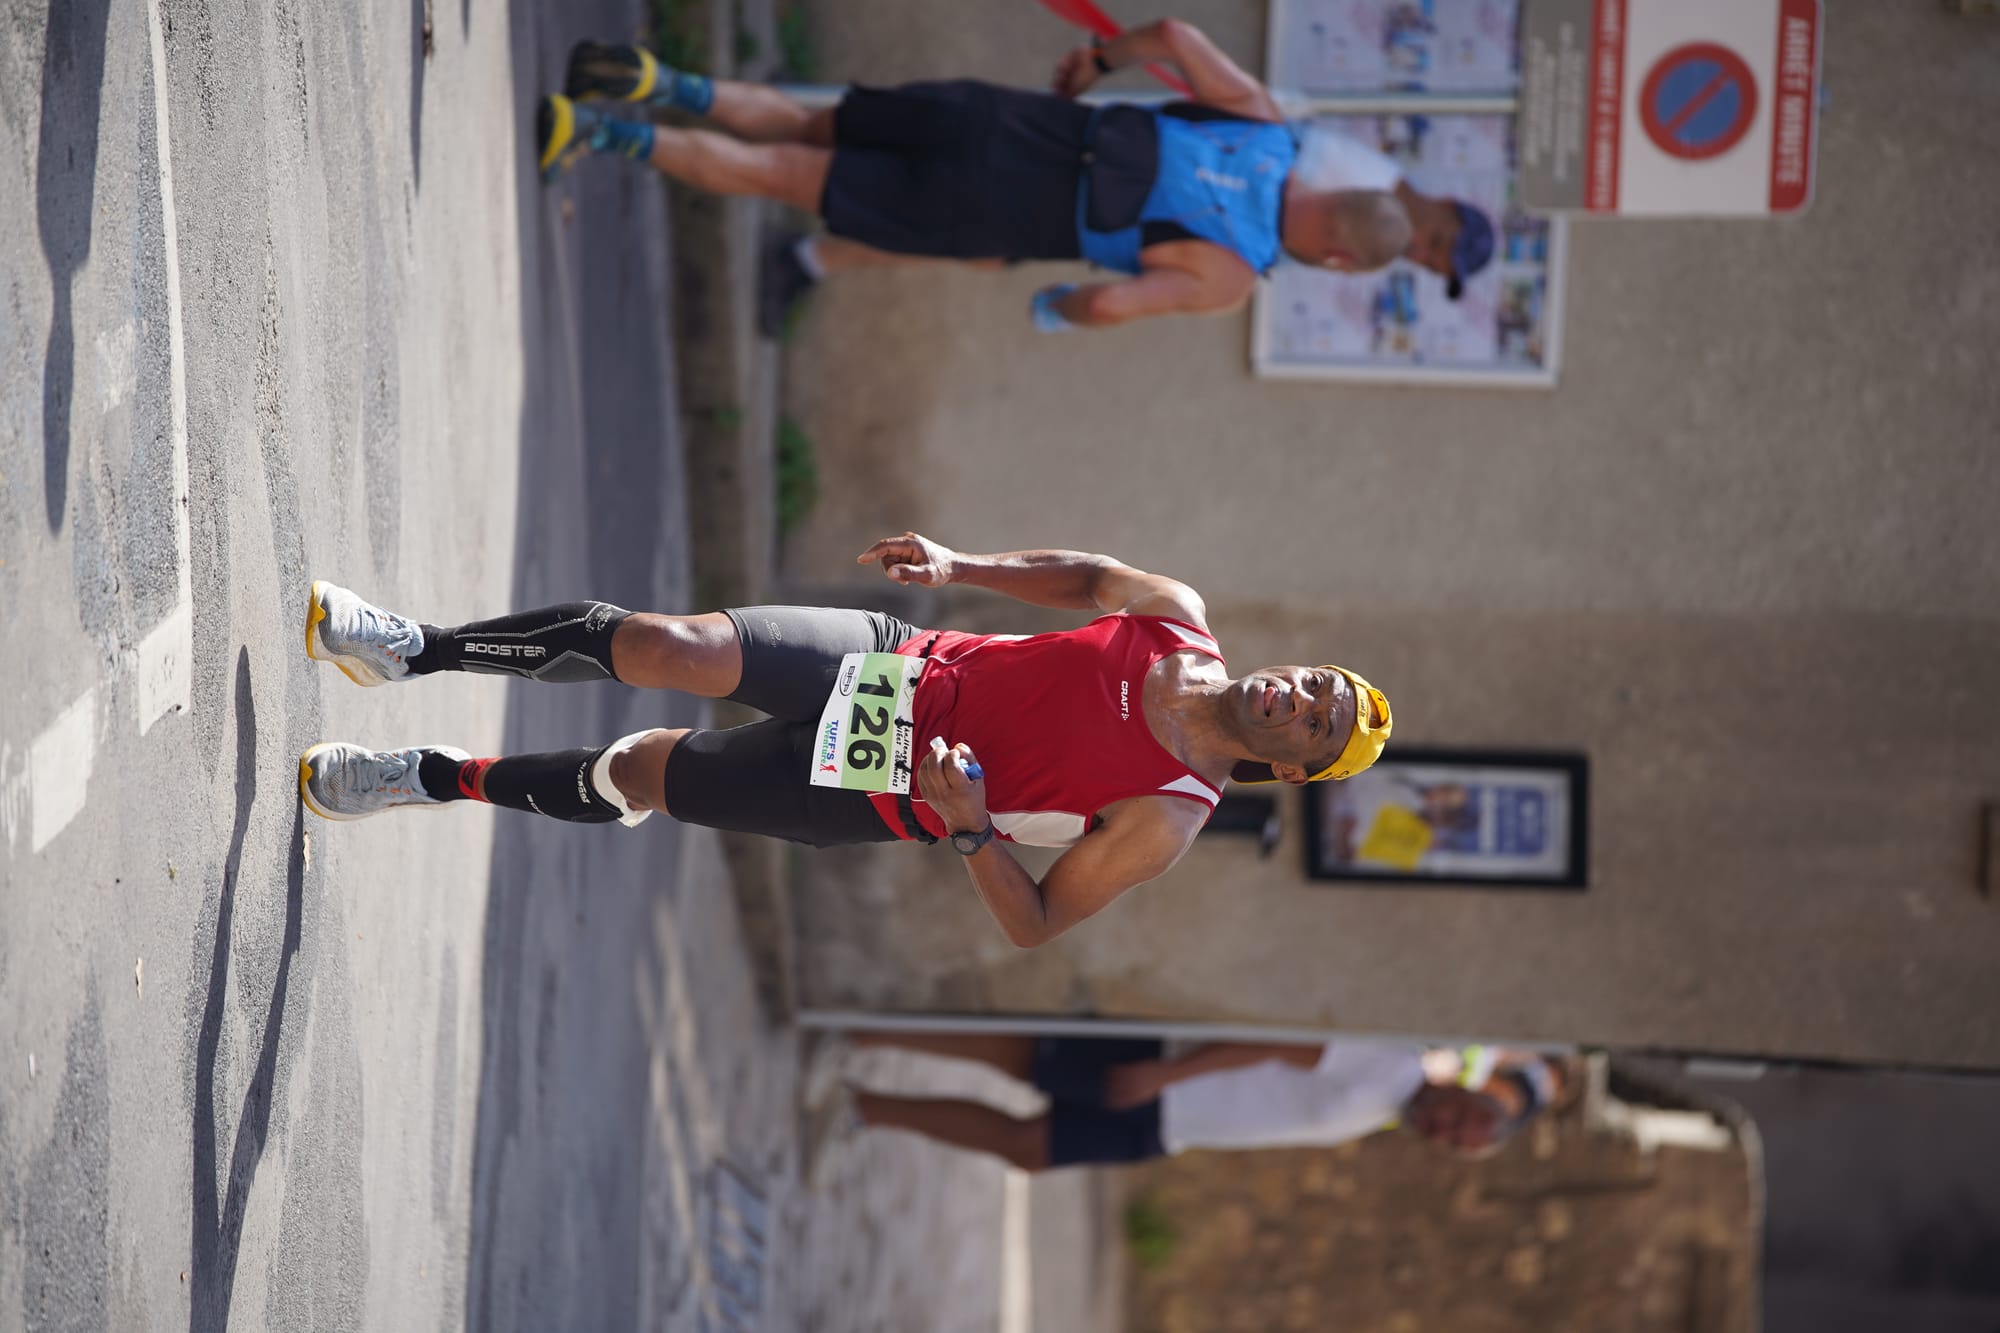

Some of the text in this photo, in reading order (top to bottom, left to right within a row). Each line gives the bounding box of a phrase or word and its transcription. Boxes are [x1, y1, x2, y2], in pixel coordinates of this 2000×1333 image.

[1776, 94, 1806, 184] MINUTE
[464, 642, 546, 657] BOOSTER
[1120, 680, 1129, 713] CRAFT
[826, 719, 839, 760] TUFF'S
[846, 673, 895, 771] 126
[820, 722, 833, 764] Aventure
